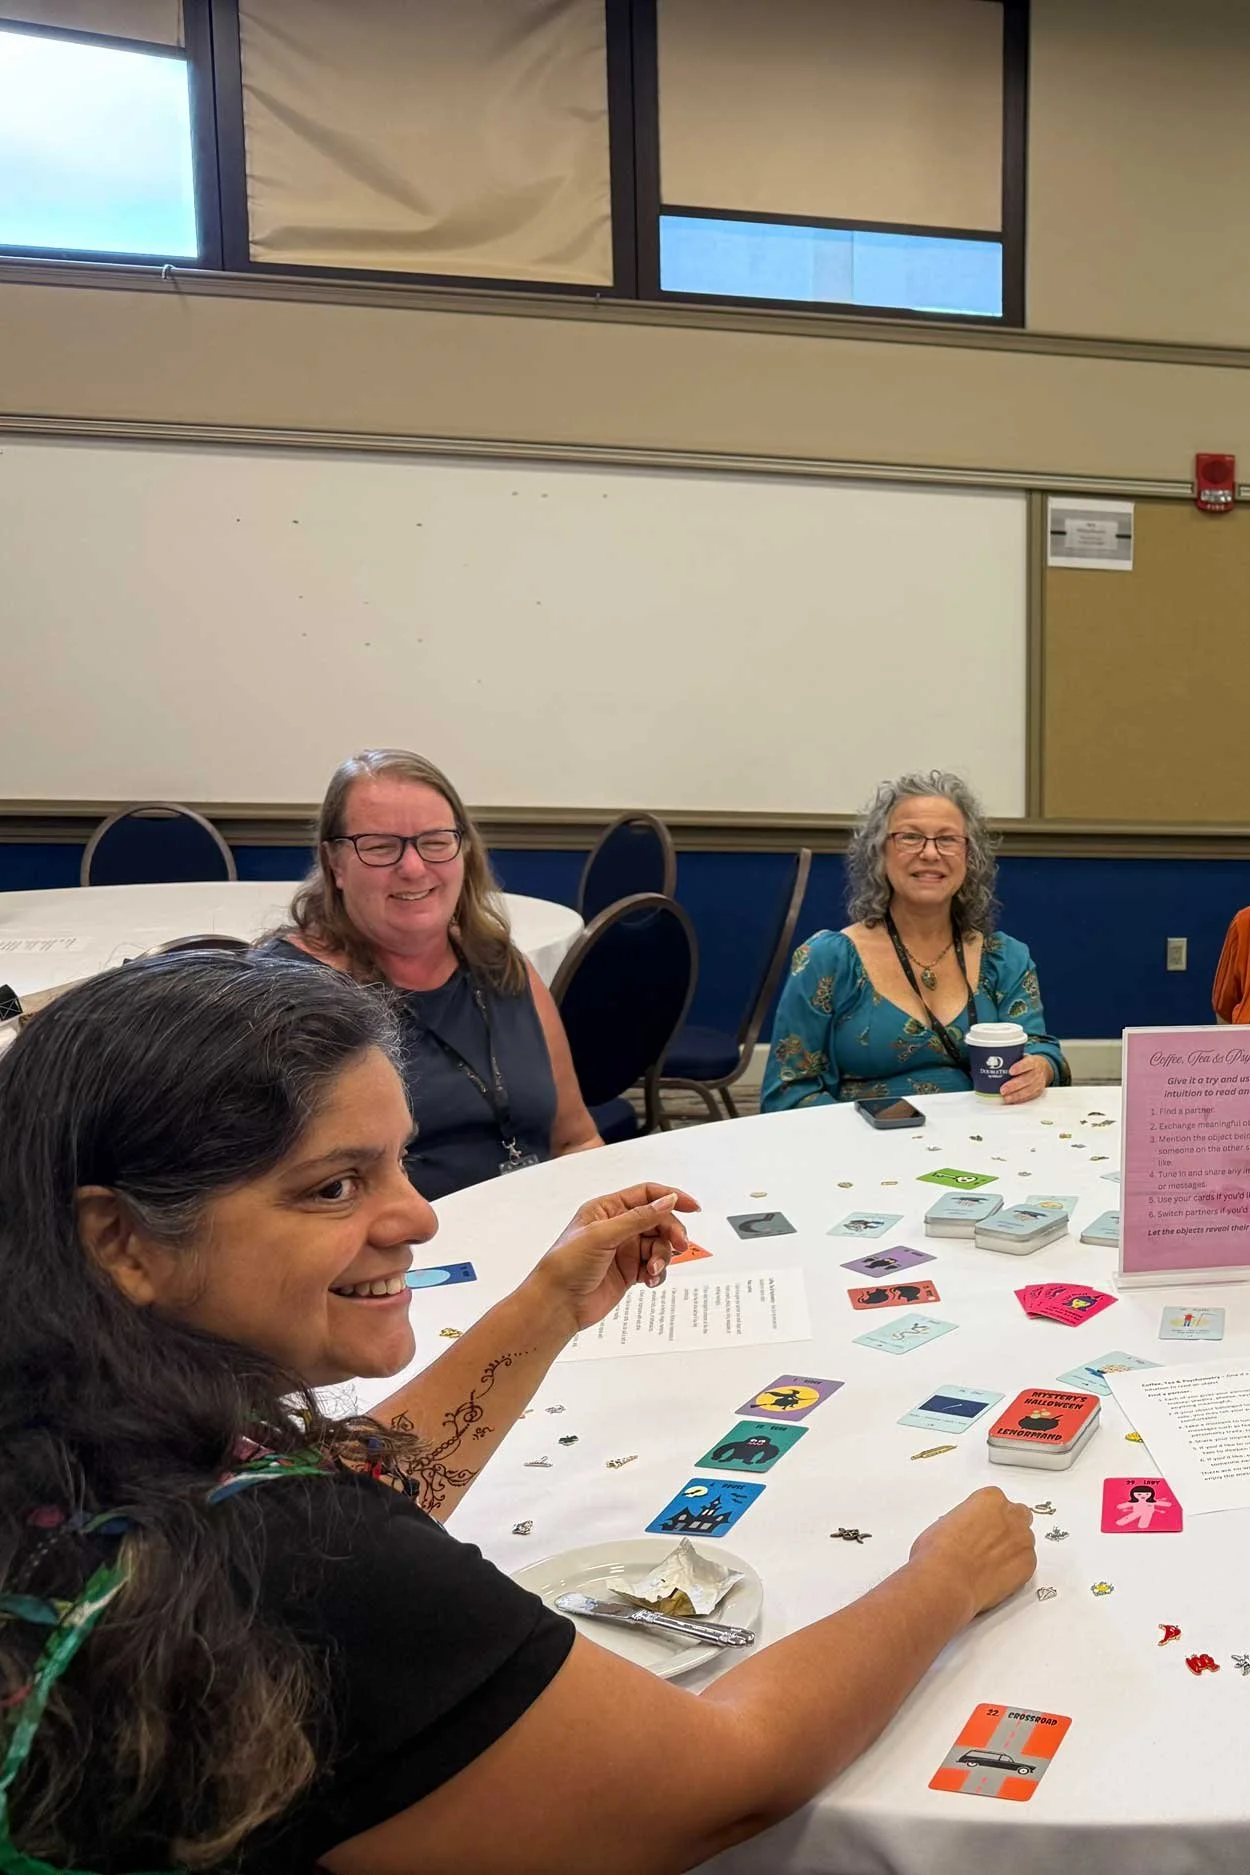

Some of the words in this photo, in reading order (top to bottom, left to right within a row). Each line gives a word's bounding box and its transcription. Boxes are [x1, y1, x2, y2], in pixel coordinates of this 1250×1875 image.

[1188, 1049, 1214, 1066] Tea
[1168, 1077, 1187, 1085] Give
[1206, 1076, 1219, 1085] try
[1220, 1075, 1238, 1083] and
[1164, 1089, 1202, 1097] intuition
[1216, 1088, 1236, 1096] read
[1160, 1107, 1176, 1115] Find
[1159, 1121, 1196, 1131] Exchange
[1198, 1119, 1241, 1130] meaningful
[1159, 1134, 1191, 1143] Mention
[1193, 1134, 1206, 1142] the
[1208, 1132, 1232, 1142] object
[1208, 1144, 1221, 1152] the
[1222, 1143, 1244, 1152] other
[1159, 1169, 1177, 1177] Tune
[1188, 1168, 1202, 1176] and
[1205, 1168, 1226, 1176] share
[1228, 1168, 1242, 1176] any
[1158, 1195, 1172, 1203] Use
[1174, 1195, 1190, 1203] your
[1194, 1193, 1215, 1202] cards
[1222, 1192, 1245, 1202] you'd
[1158, 1209, 1183, 1218] Switch
[1185, 1207, 1218, 1218] partners
[1226, 1206, 1249, 1216] you'd
[1148, 1228, 1161, 1236] Let
[1162, 1227, 1174, 1235] the
[1176, 1226, 1204, 1236] objects
[1206, 1224, 1229, 1233] reveal
[1231, 1224, 1249, 1232] their
[1032, 1392, 1087, 1402] MYSTERY'S
[1024, 1399, 1083, 1410] HALLOWEEN
[997, 1428, 1062, 1440] LENORMAND
[1008, 1712, 1058, 1726] CROSSROAD
